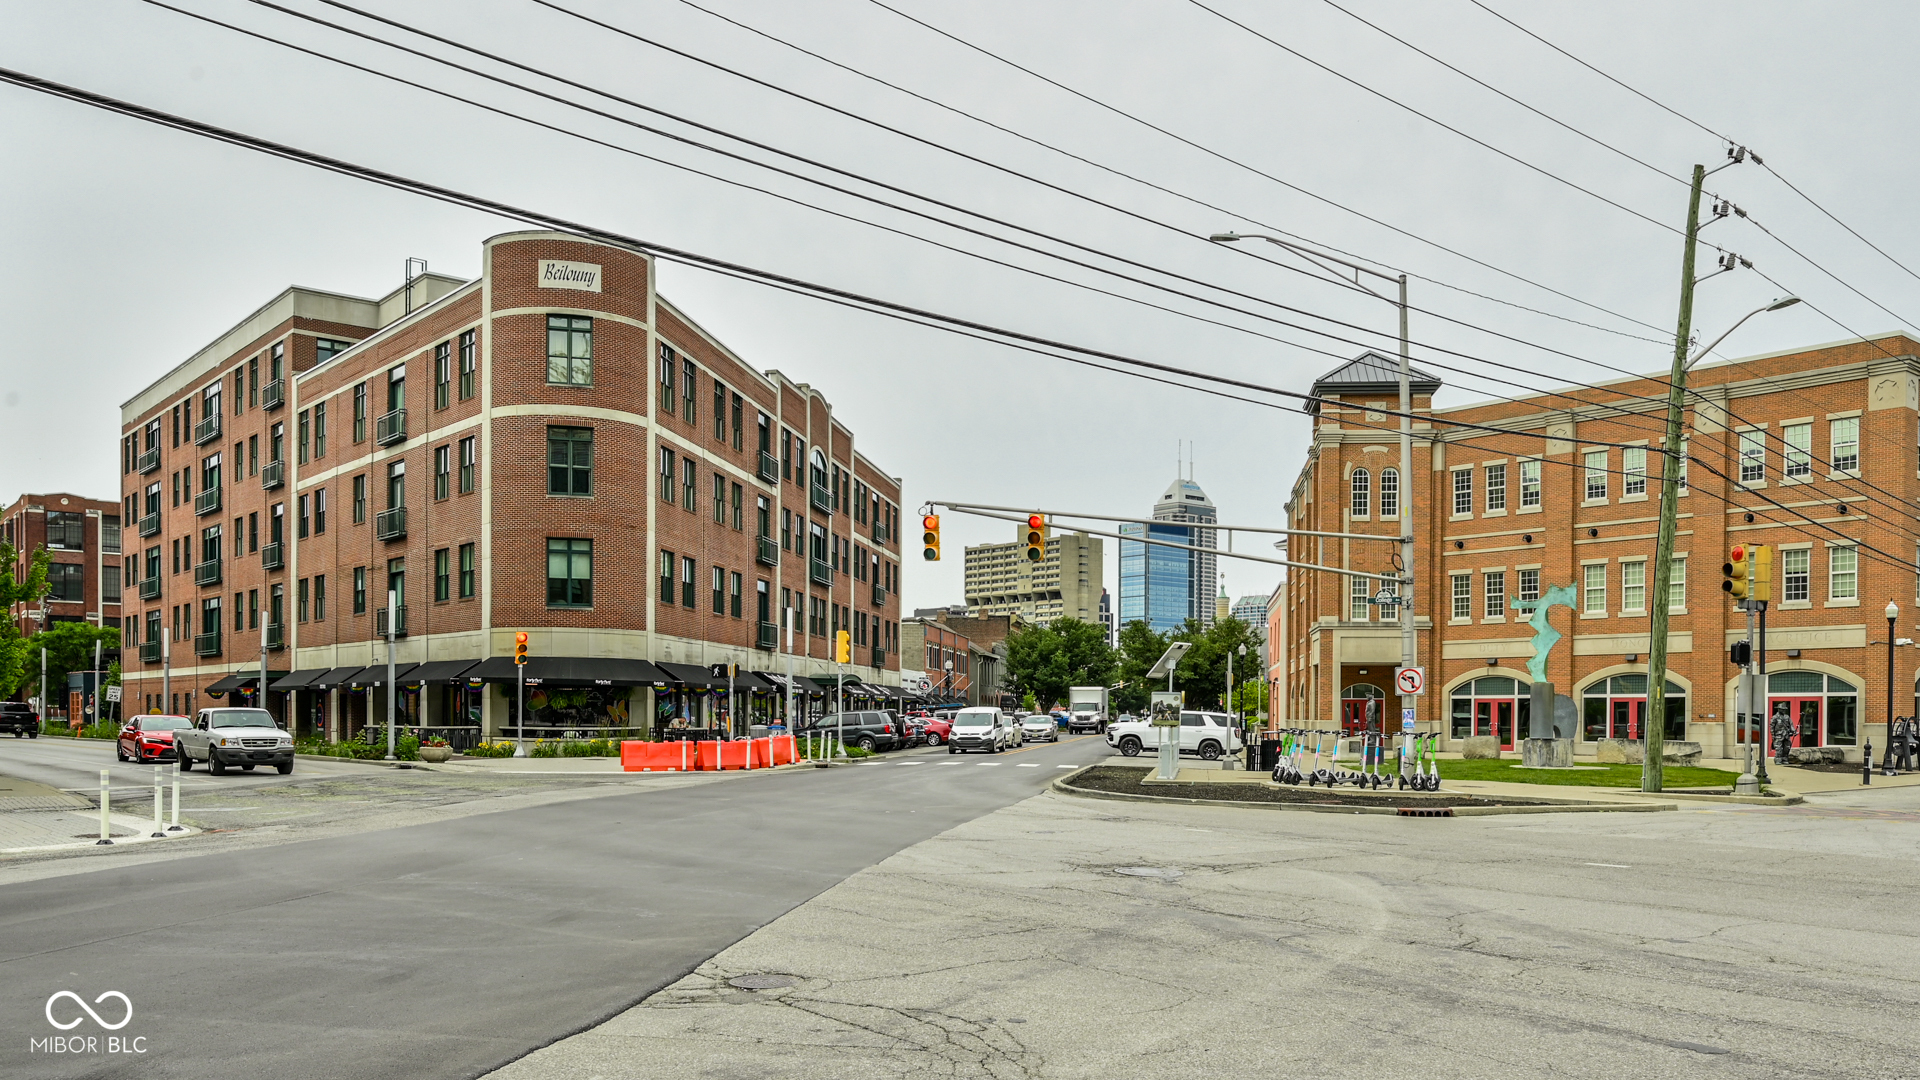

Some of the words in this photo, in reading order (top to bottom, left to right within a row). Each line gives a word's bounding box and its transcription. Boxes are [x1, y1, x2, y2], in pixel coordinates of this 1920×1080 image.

[543, 263, 596, 287] Beilouny
[1765, 632, 1832, 643] ACRIFICE
[1479, 643, 1508, 652] DUTY
[1611, 639, 1650, 649] HONO
